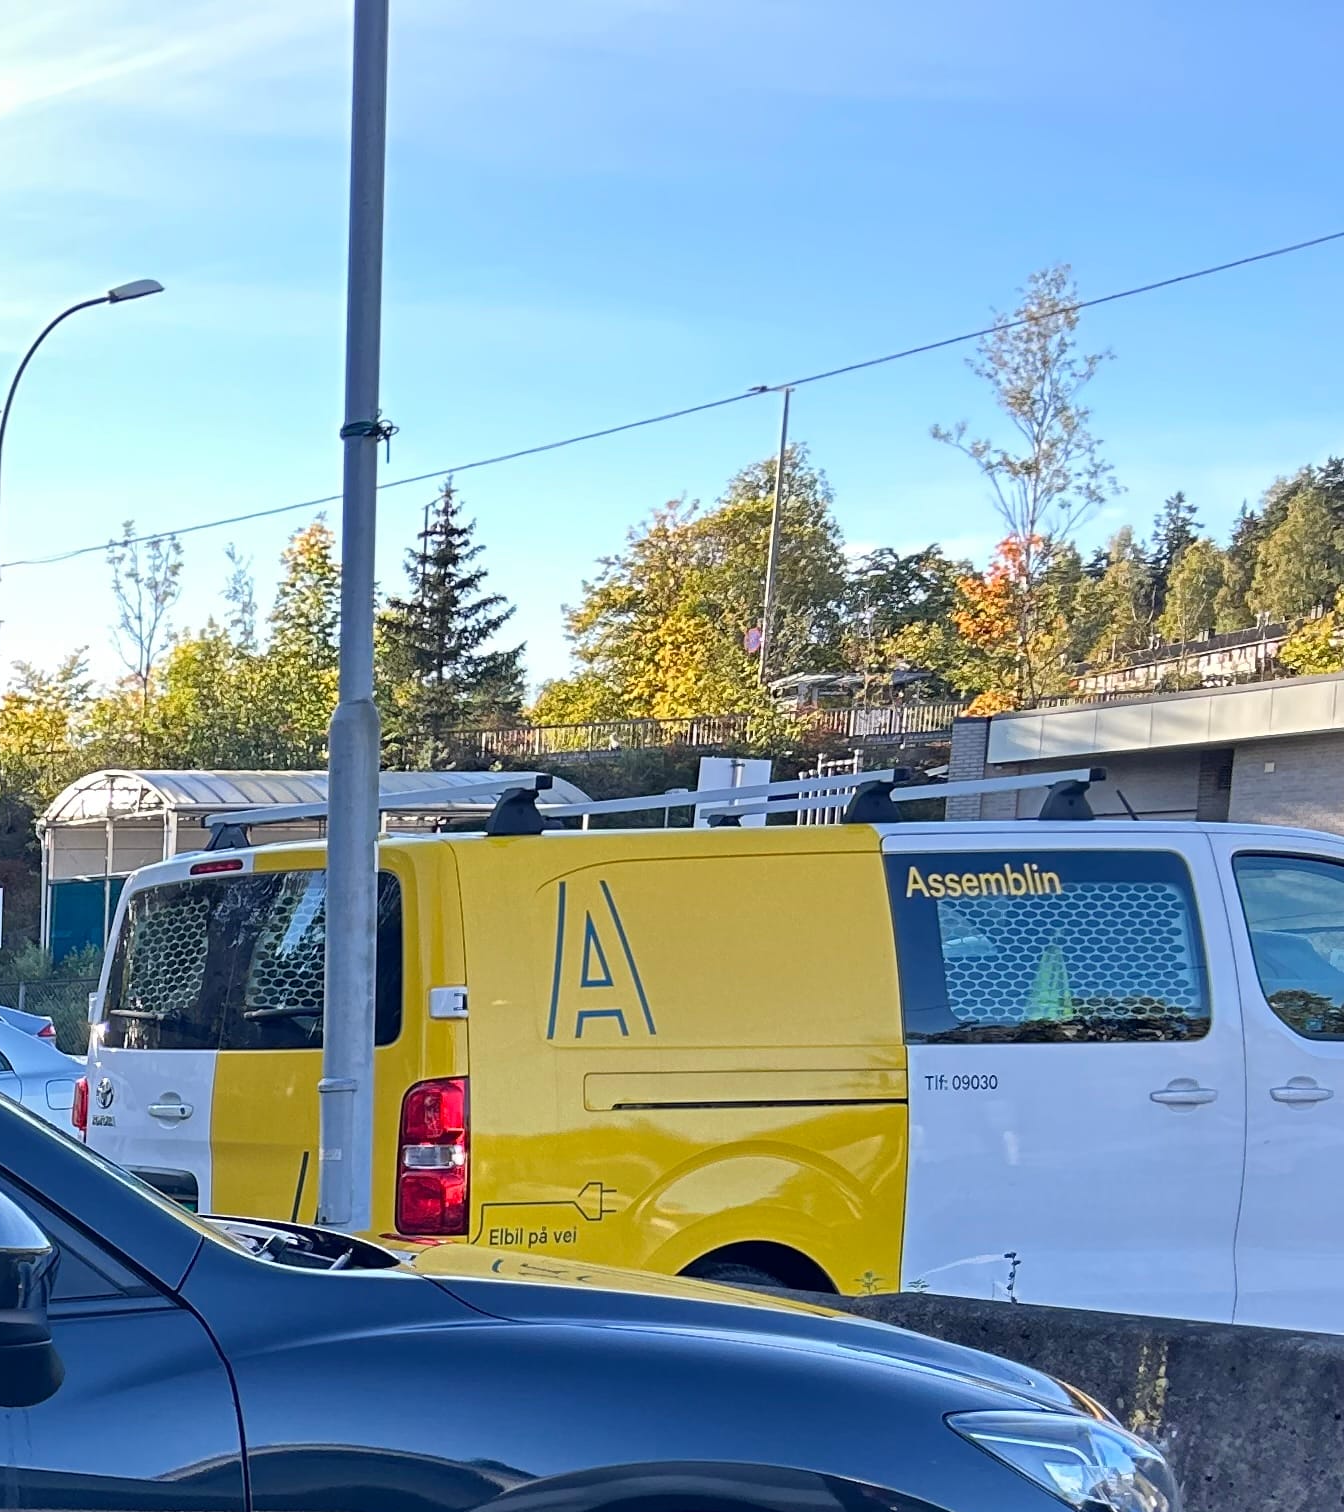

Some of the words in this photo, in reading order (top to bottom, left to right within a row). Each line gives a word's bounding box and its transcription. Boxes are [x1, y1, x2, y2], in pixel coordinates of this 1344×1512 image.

[906, 863, 1062, 898] Assemblin
[924, 1074, 948, 1090] Tlf:
[952, 1074, 998, 1090] 09030
[489, 1228, 523, 1246] Elbil
[528, 1226, 548, 1248] på
[553, 1226, 577, 1244] vei
